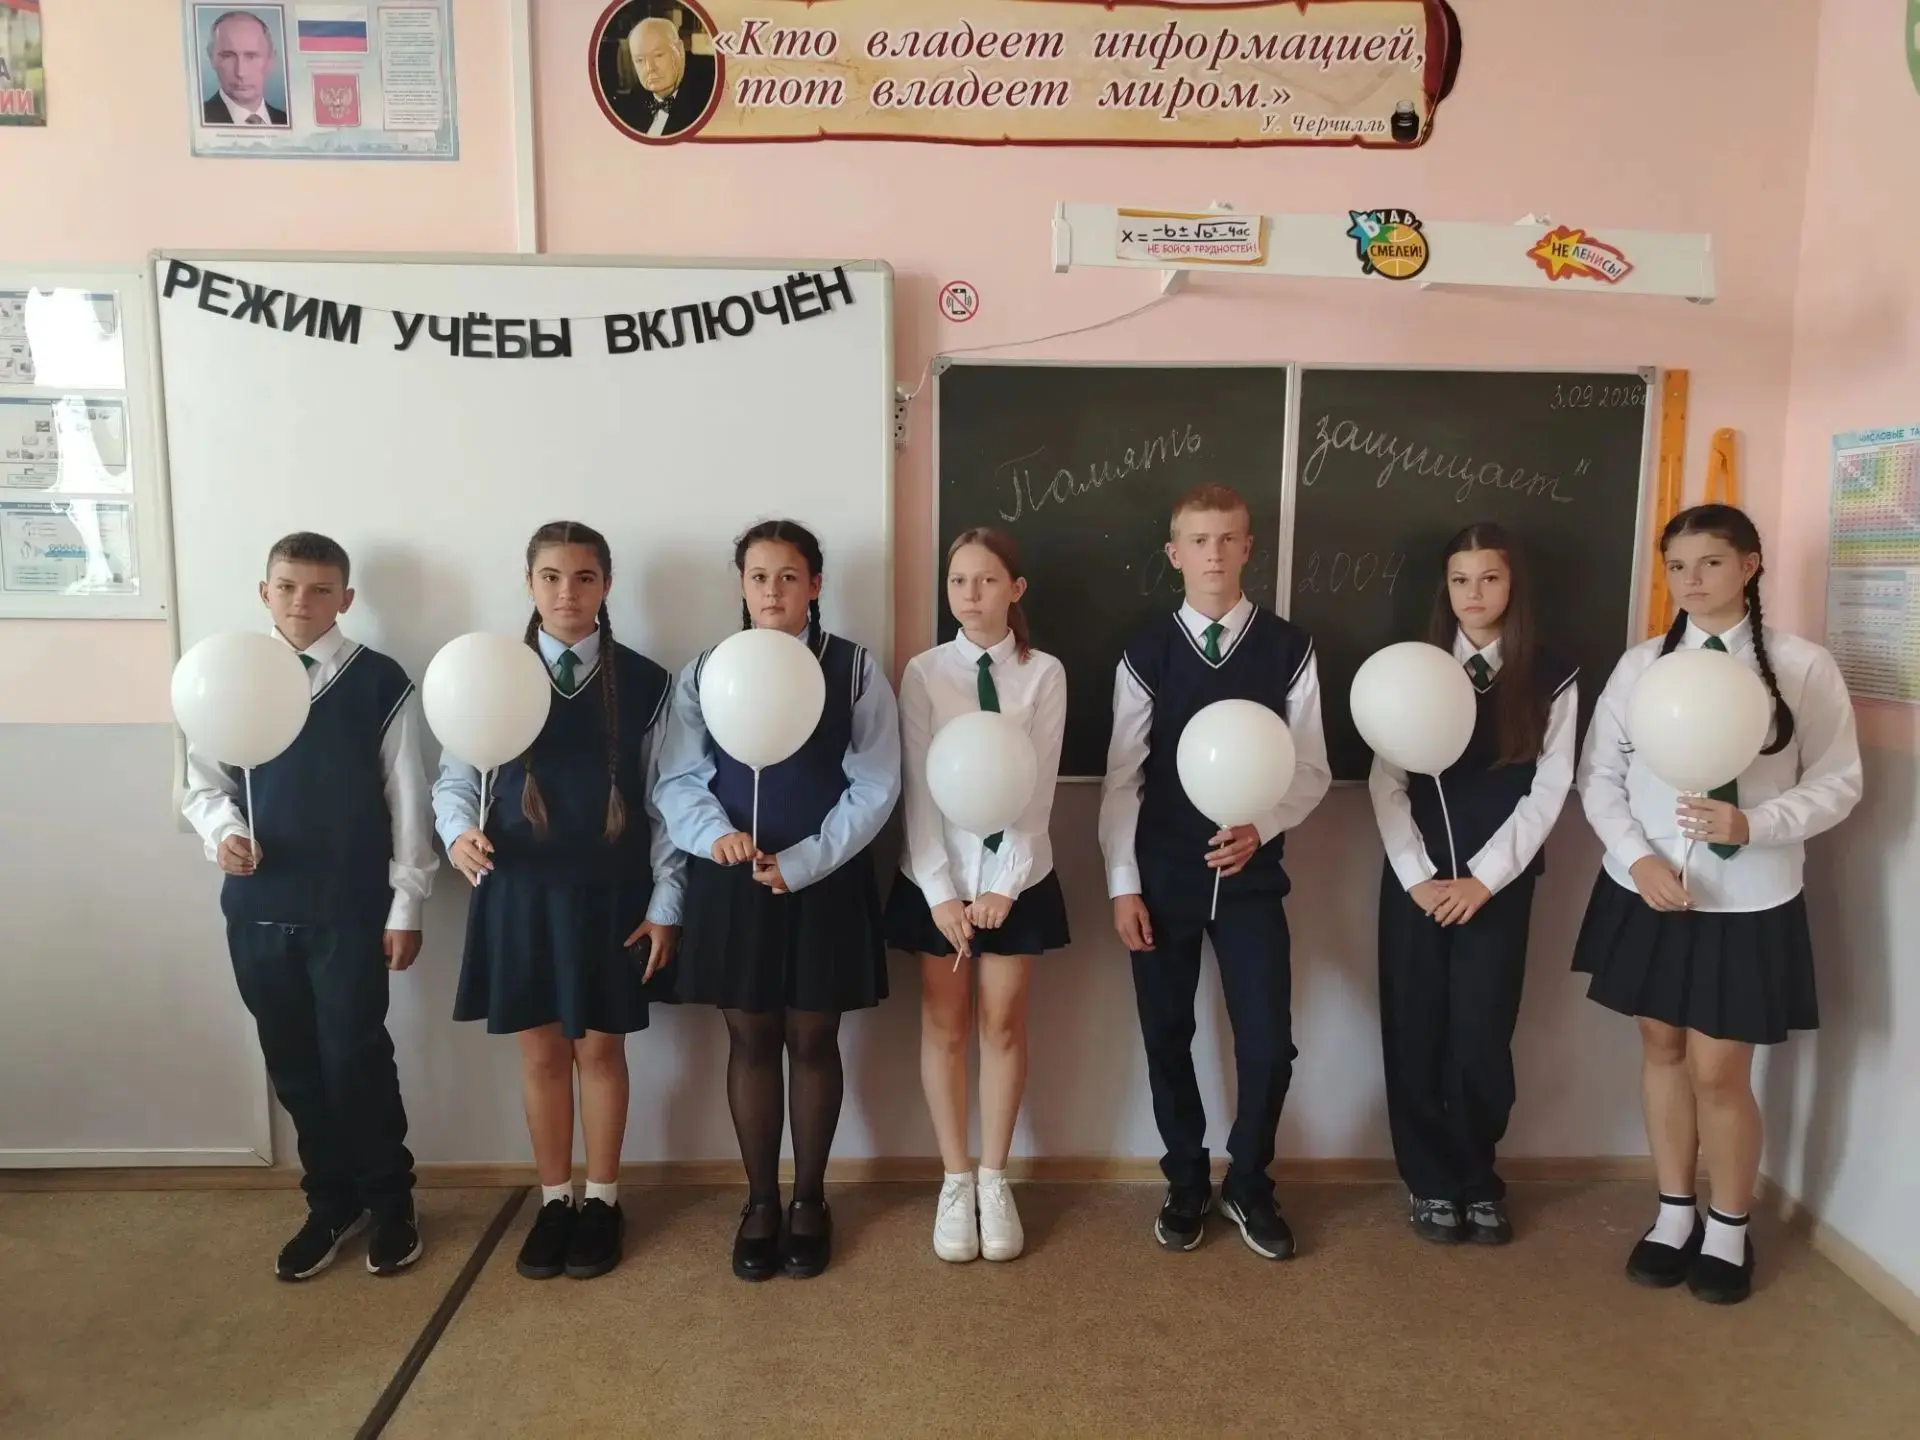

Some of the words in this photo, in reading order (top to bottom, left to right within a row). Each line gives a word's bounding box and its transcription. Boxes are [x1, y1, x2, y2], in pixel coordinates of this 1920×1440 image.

[715, 20, 838, 58] «Кто
[866, 19, 1065, 59] владеет
[1093, 20, 1426, 70] информацией,
[737, 78, 843, 106] тот
[872, 69, 1070, 107] владеет
[1098, 80, 1292, 119] миром.»
[1292, 113, 1387, 133] Черчилль
[1147, 243, 1160, 254] НЕ
[1163, 243, 1191, 255] БОЙСЯ
[1194, 243, 1257, 256] ТРУДНОСТЕЙ!
[1369, 243, 1423, 258] СМЕЛЕЙ!
[1551, 242, 1570, 258] НЕ
[162, 258, 363, 345] РЕЖИМ
[391, 310, 572, 359] УЧЁБЫ
[603, 265, 856, 355] ВКЛЮЧЁН
[993, 423, 1201, 522] Память
